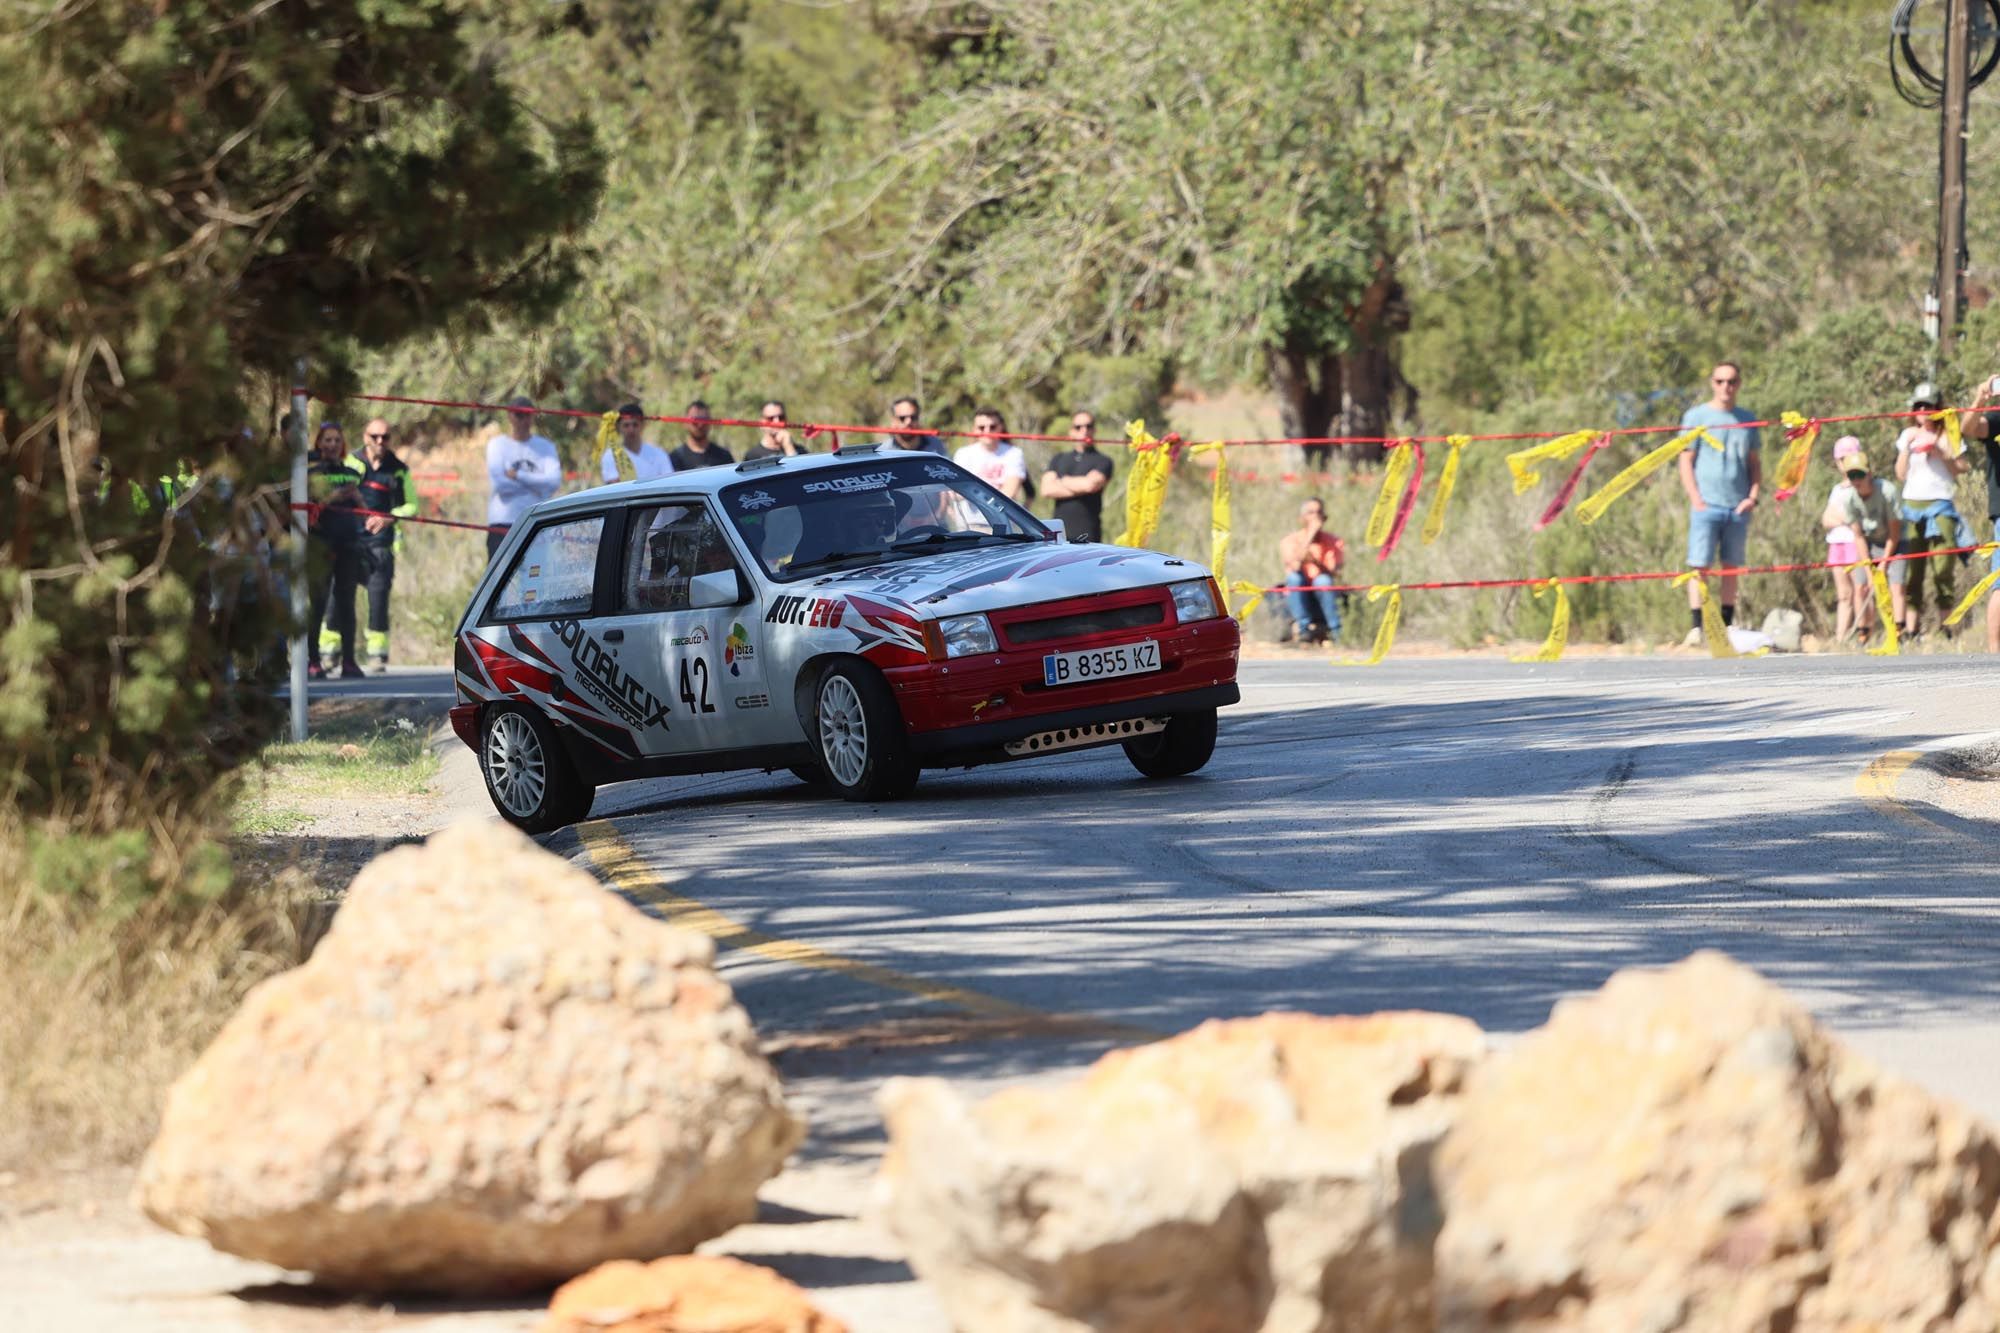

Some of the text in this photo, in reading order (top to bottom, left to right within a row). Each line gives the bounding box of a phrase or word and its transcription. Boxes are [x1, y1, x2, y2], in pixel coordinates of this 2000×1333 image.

[802, 471, 899, 493] SOLNAUTIX
[734, 643, 754, 655] Ibiza
[1056, 645, 1157, 680] B 8355 KZ
[574, 670, 643, 731] MECANIZADOS
[680, 656, 716, 714] 42
